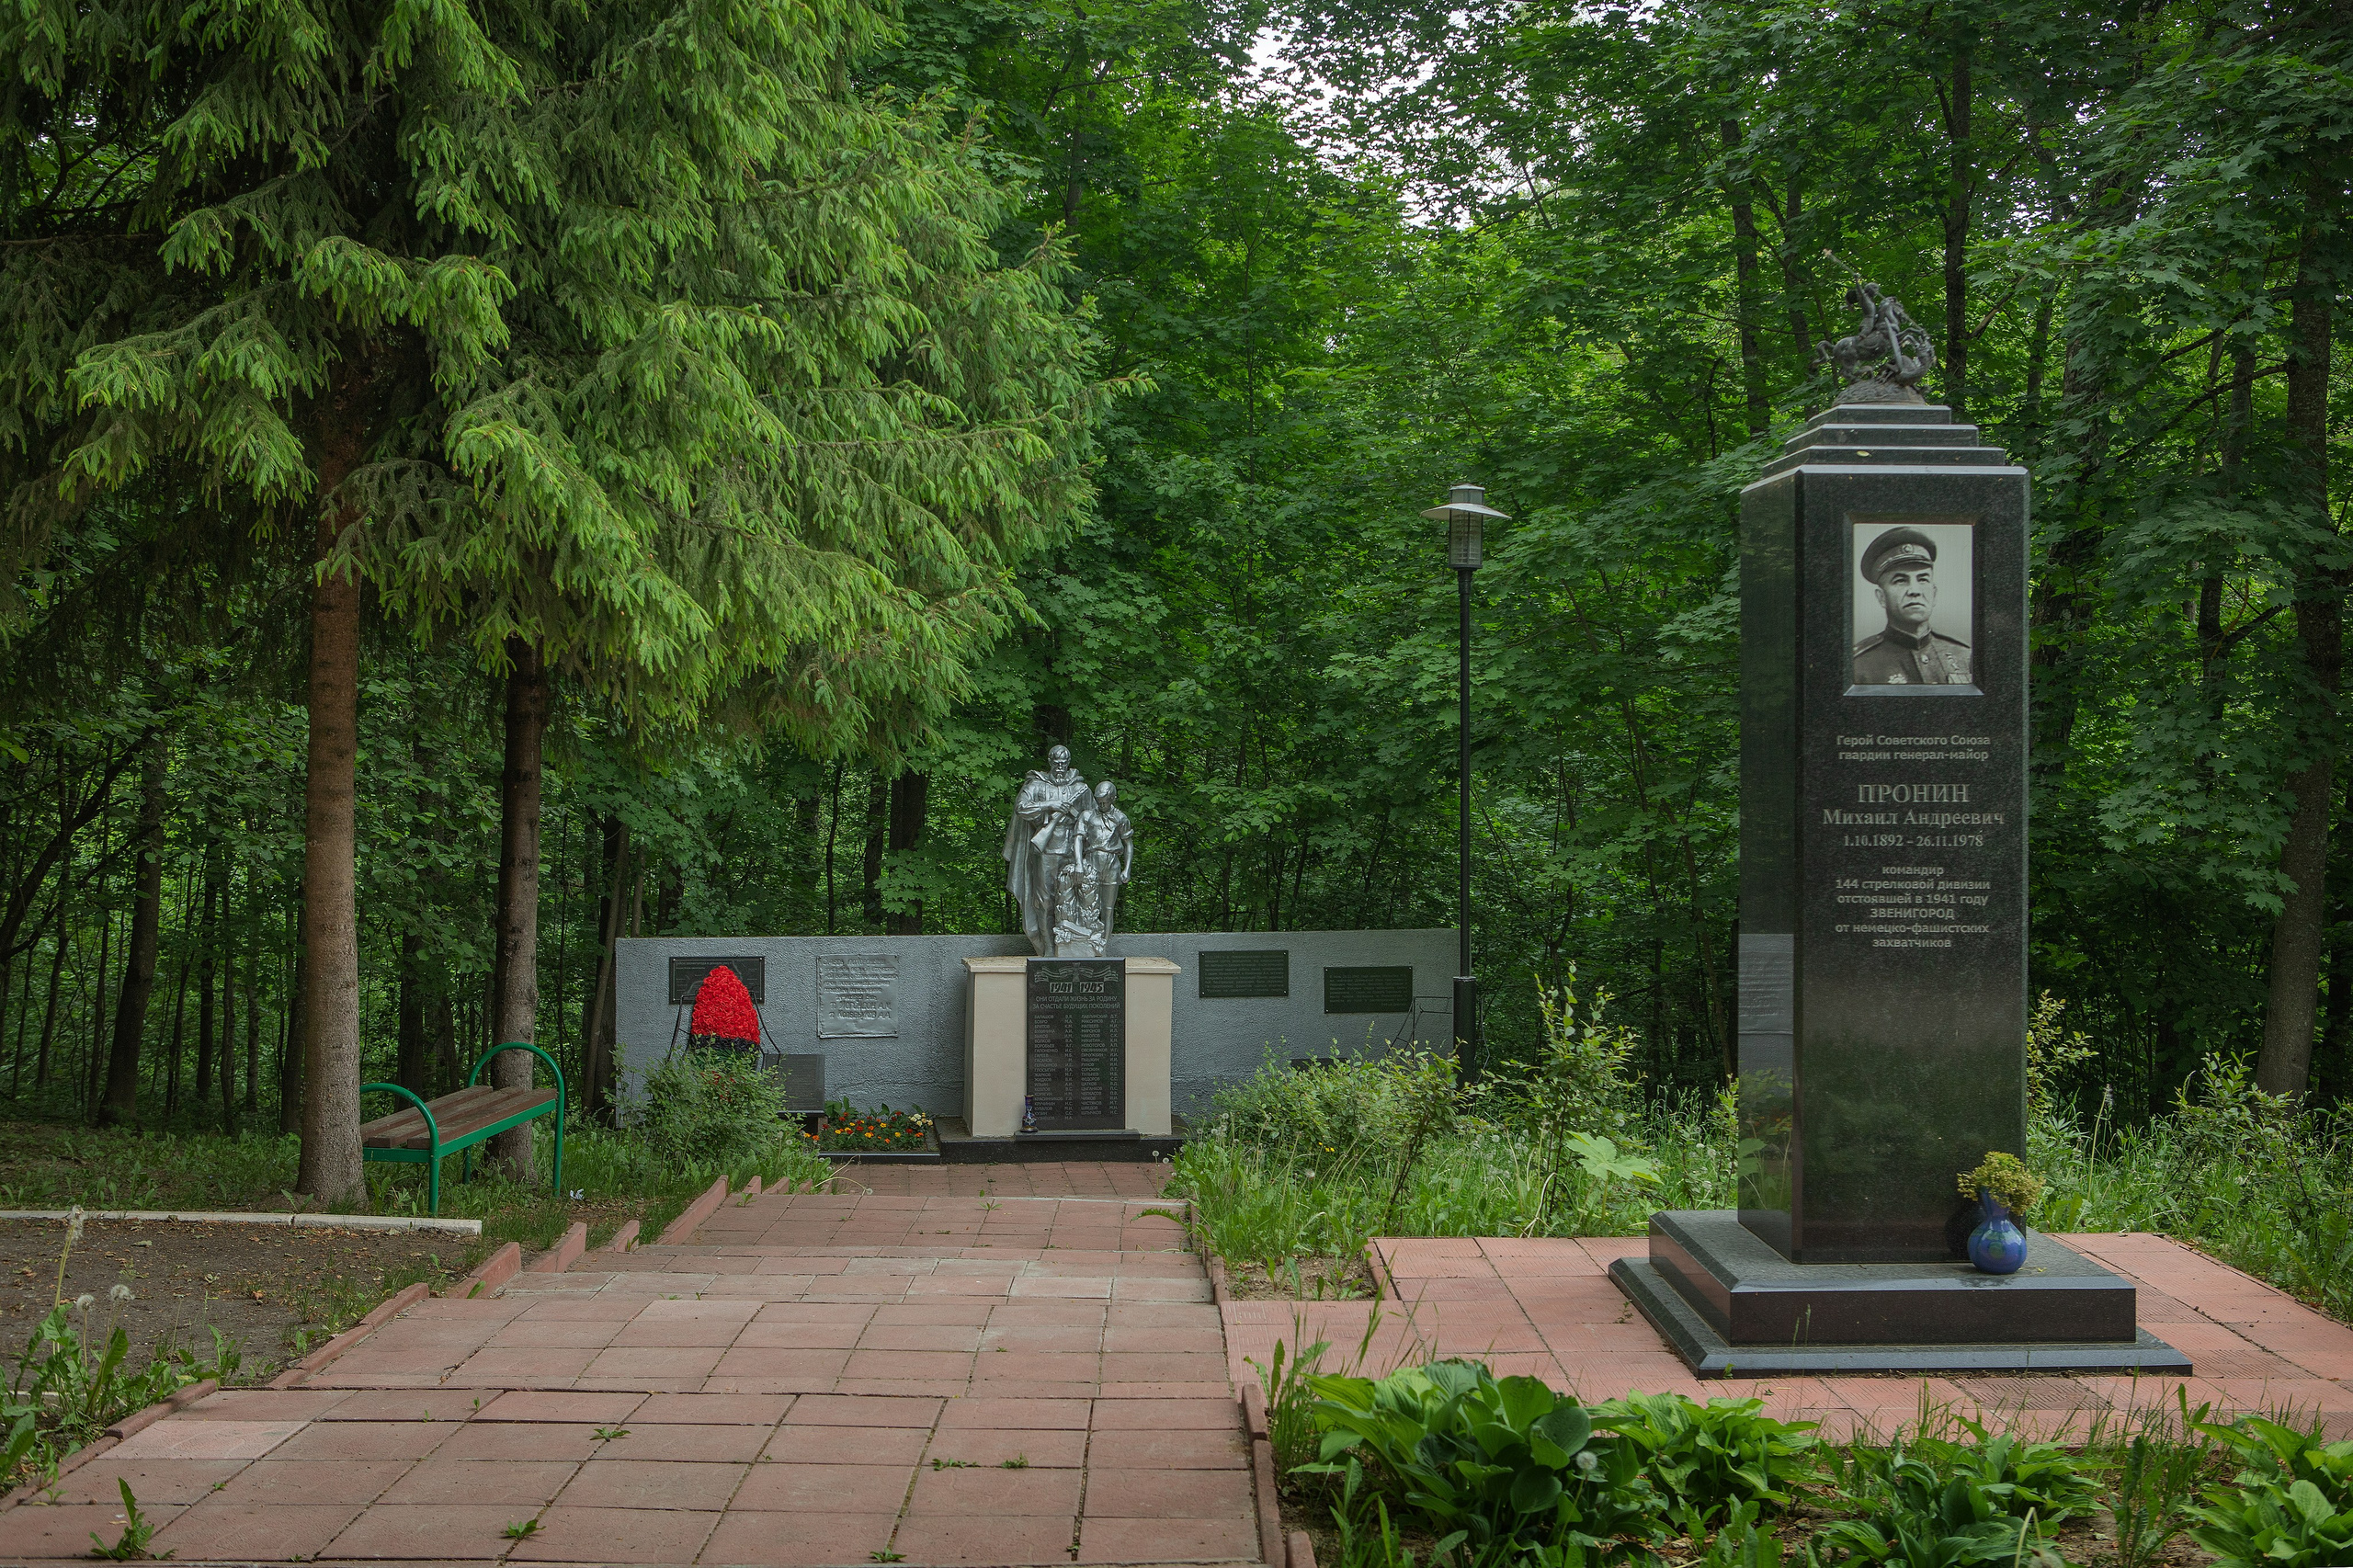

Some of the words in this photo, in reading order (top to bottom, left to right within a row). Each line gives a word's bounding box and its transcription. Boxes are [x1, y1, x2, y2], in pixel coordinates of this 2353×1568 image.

[1836, 734, 1874, 746] Герой
[1876, 735, 1948, 745] Советского
[1949, 735, 1991, 745] Союза
[1838, 750, 1891, 761] гвардии
[1893, 749, 1989, 761] генерал-майор
[1858, 783, 1971, 803] ПРОНИН
[1823, 809, 1898, 825] Михаил
[1904, 809, 2006, 829] Андреевич
[1844, 835, 1904, 846] 1.10.1892
[1916, 835, 1984, 846] 26.11.1978
[1881, 866, 1944, 876] командир
[1836, 880, 1859, 889] 144
[1861, 879, 1934, 891] стрелковой
[1937, 881, 1991, 890] дивизии
[1836, 893, 1912, 903] отстоявшей
[1926, 894, 1956, 903] 1941
[1960, 896, 1989, 907] году
[1870, 908, 1955, 920] ЗВЕНИГОРОД
[1835, 925, 1850, 933] от
[1853, 922, 1990, 936] немецко-фашистских
[1872, 938, 1952, 948] захватчиков
[1051, 983, 1072, 993] 1941
[1080, 983, 1103, 993] 1945
